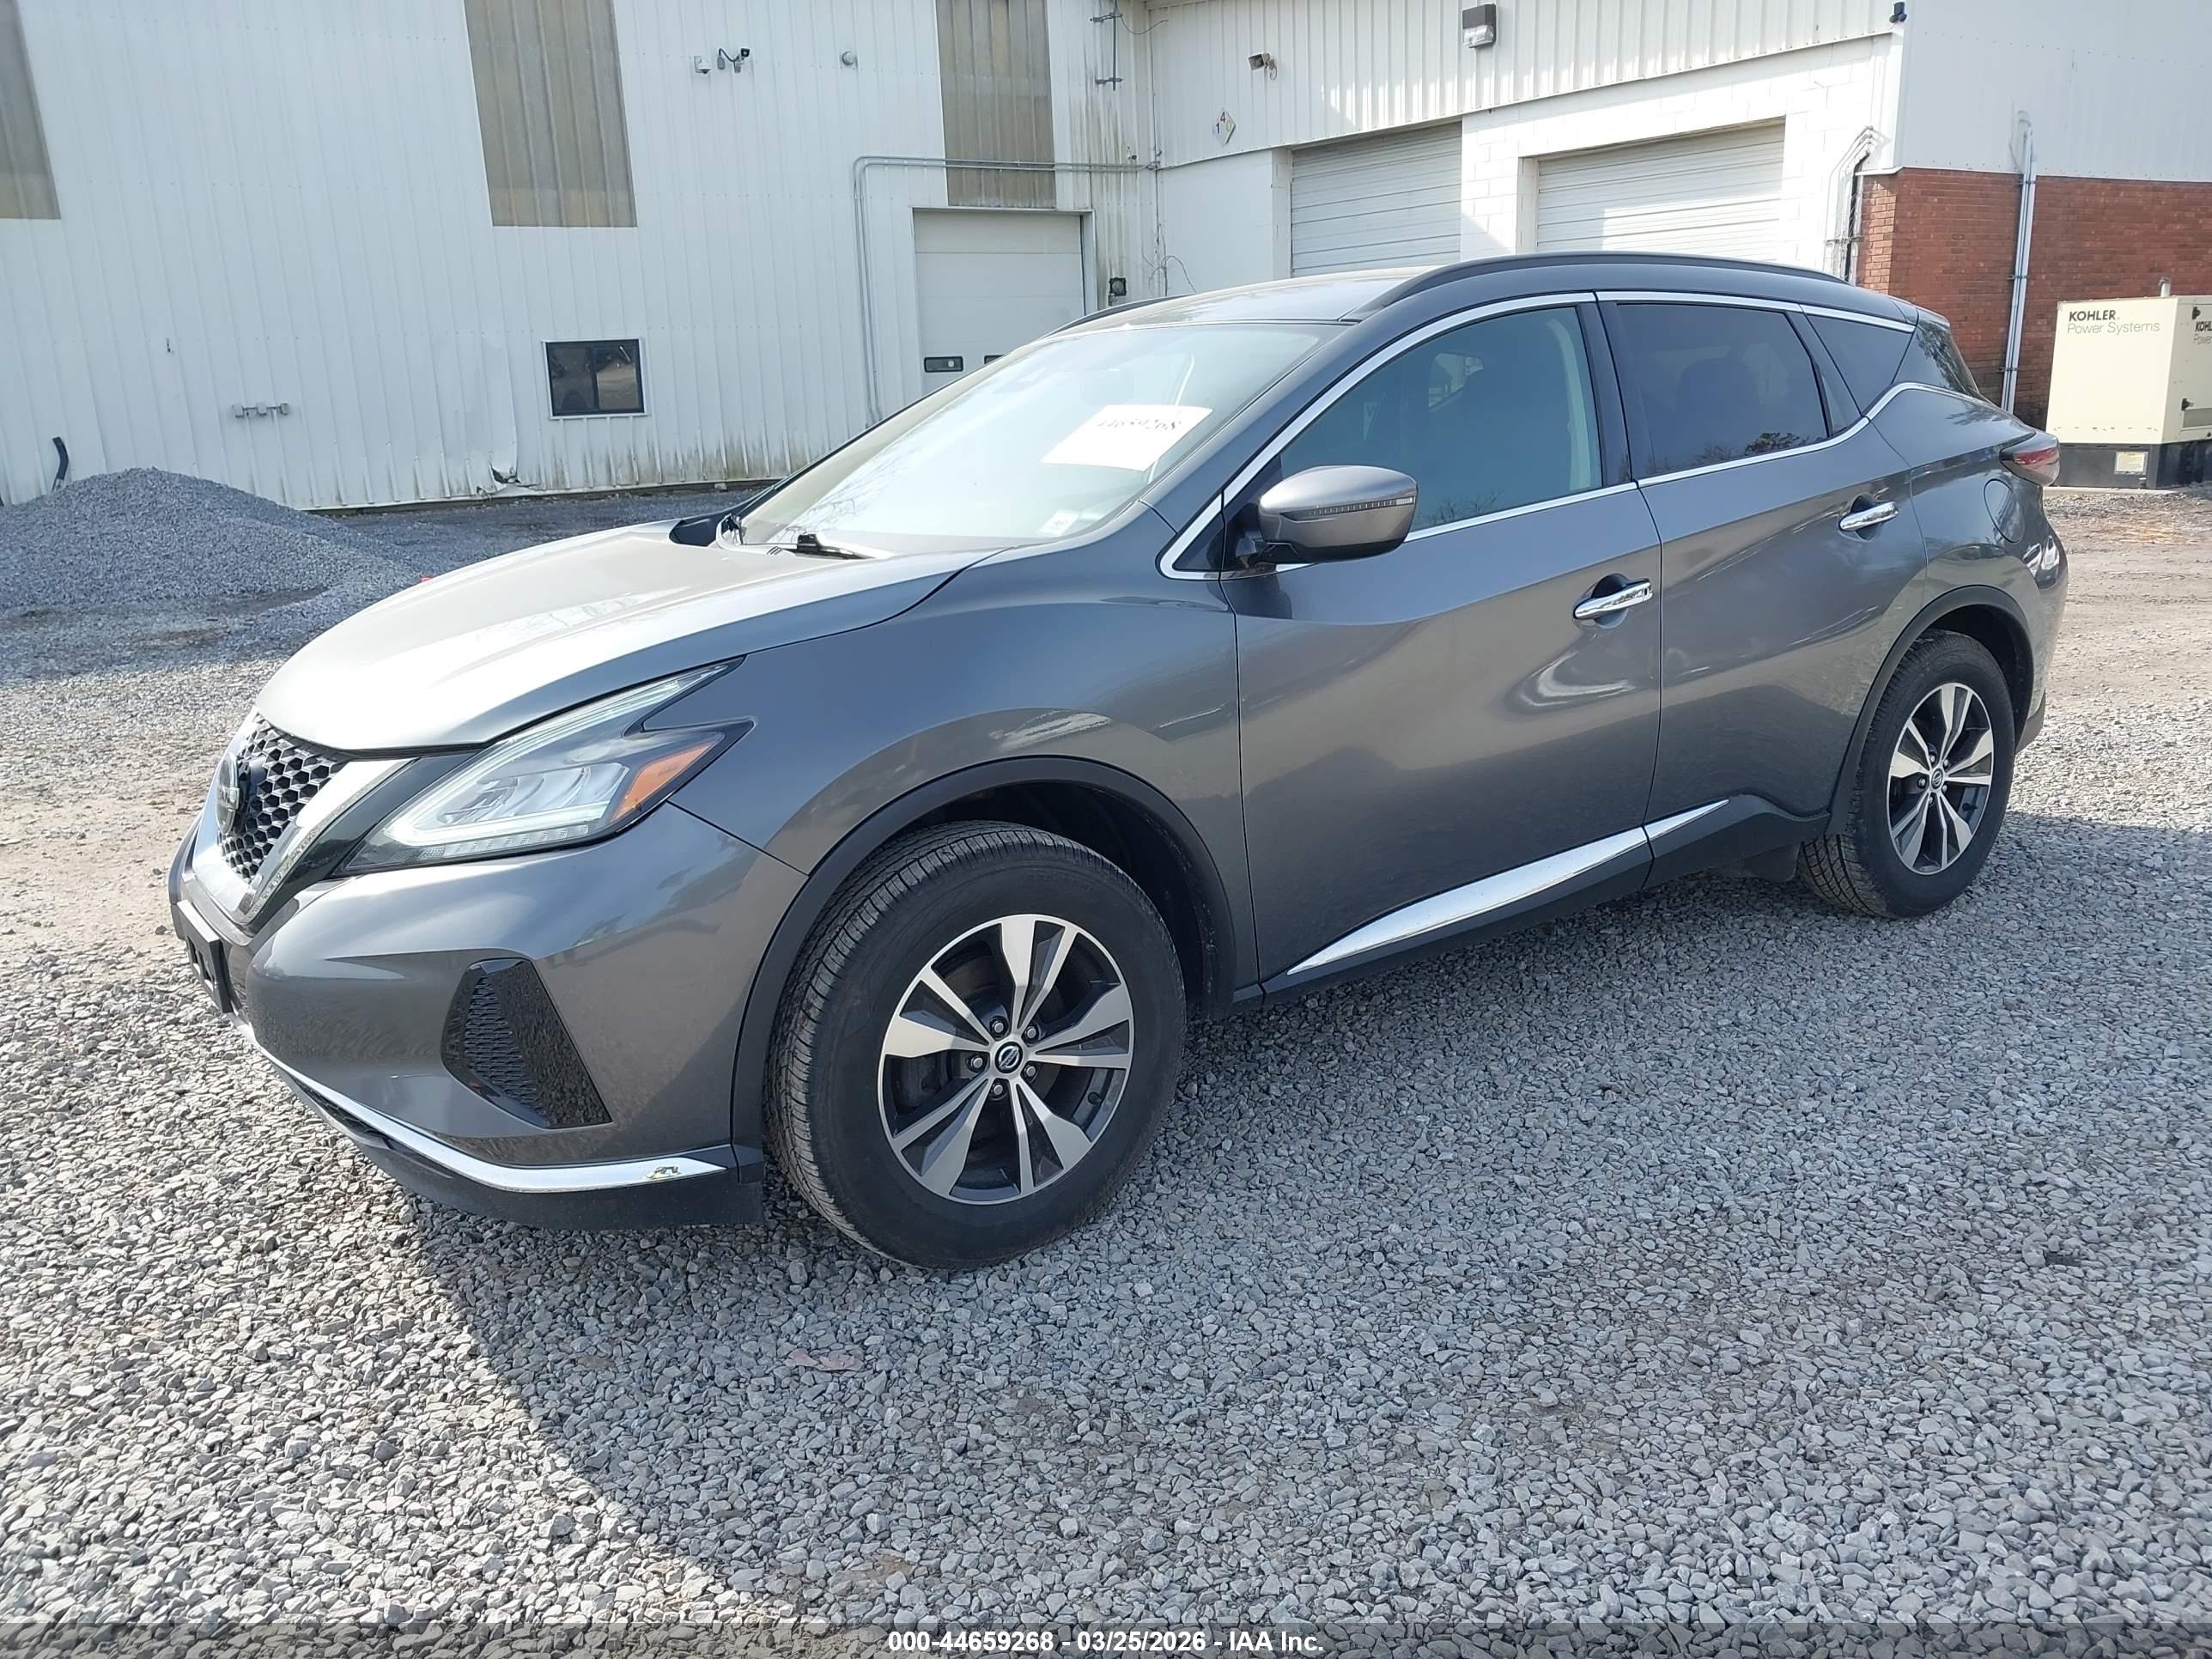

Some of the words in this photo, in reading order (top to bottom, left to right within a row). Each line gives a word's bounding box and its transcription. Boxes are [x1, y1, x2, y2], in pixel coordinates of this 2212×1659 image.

[1219, 111, 1226, 124] 4
[1215, 122, 1220, 134] 1
[2069, 309, 2116, 322] KOHLER
[2067, 322, 2104, 334] Power
[2107, 321, 2160, 336] Systems
